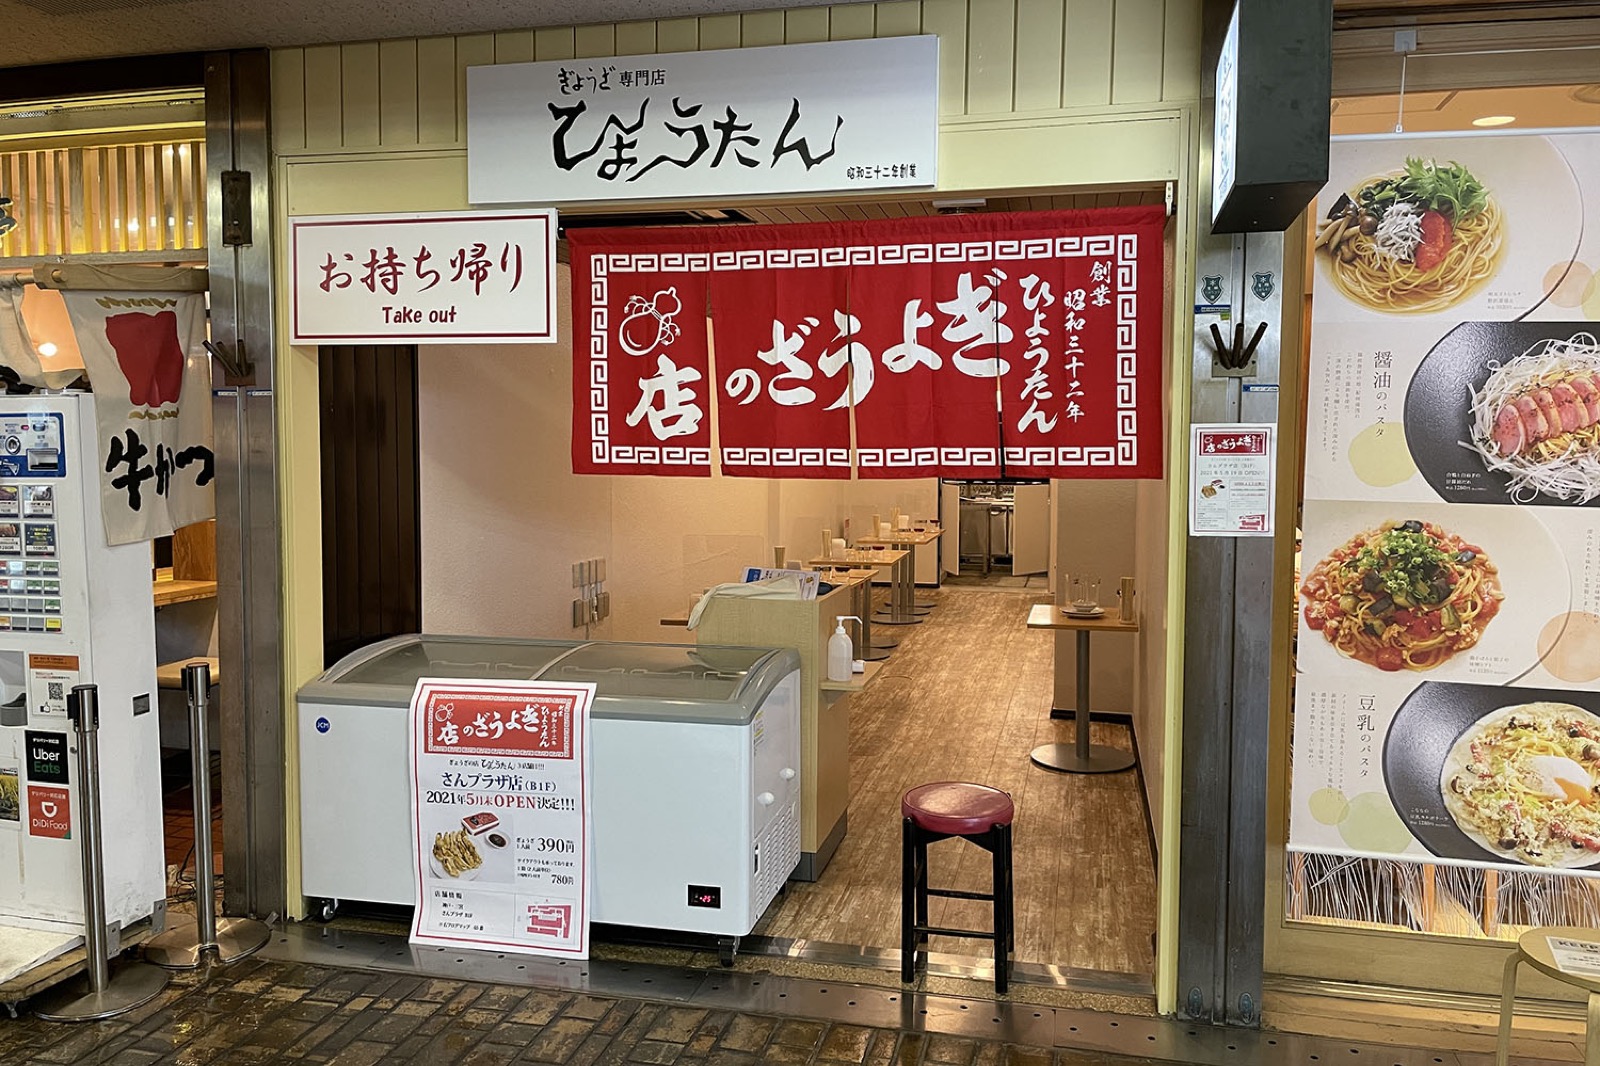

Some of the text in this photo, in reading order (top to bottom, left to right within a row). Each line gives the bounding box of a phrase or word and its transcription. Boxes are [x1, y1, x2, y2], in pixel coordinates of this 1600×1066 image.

[547, 97, 844, 182] ひょうたん
[847, 163, 917, 180] 昭和三十二年創業
[319, 242, 523, 296] お持ち帰り
[1091, 260, 1112, 306] 創業
[382, 305, 457, 323] Take out
[1017, 272, 1059, 434] ひょうたん
[1064, 289, 1086, 420] 昭和三十二年
[1373, 351, 1393, 438] 醤油のパスタ
[33, 748, 60, 761] Uber
[1357, 694, 1375, 777] 豆乳のパスタ
[34, 761, 61, 774] Eats
[49, 820, 68, 830] Food
